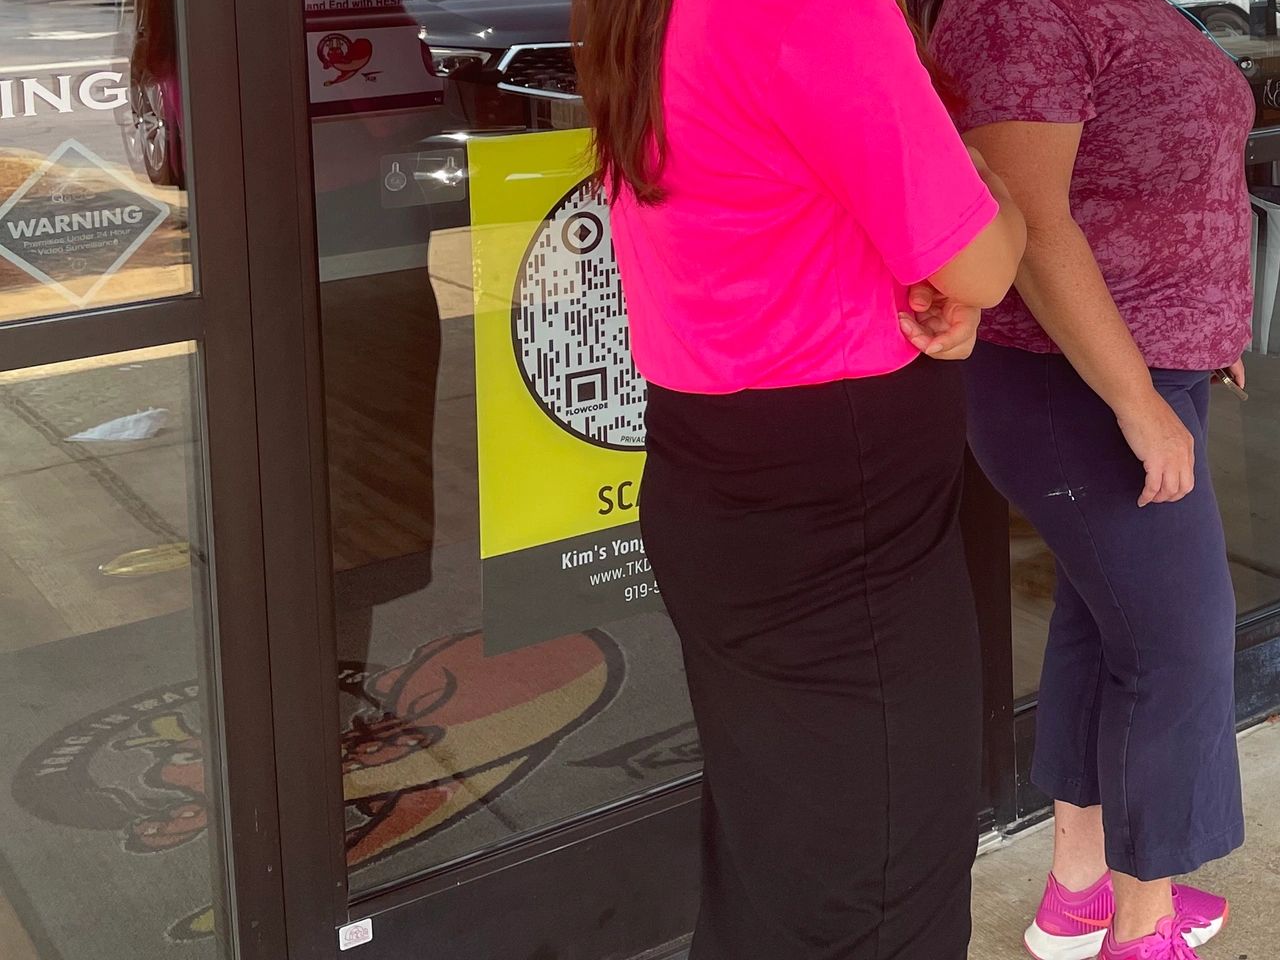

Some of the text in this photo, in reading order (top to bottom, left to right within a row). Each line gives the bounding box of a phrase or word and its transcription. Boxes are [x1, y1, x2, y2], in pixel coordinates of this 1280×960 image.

[7, 205, 143, 239] WARNING
[565, 401, 608, 417] FLOWCODE
[561, 543, 607, 570] Kim's
